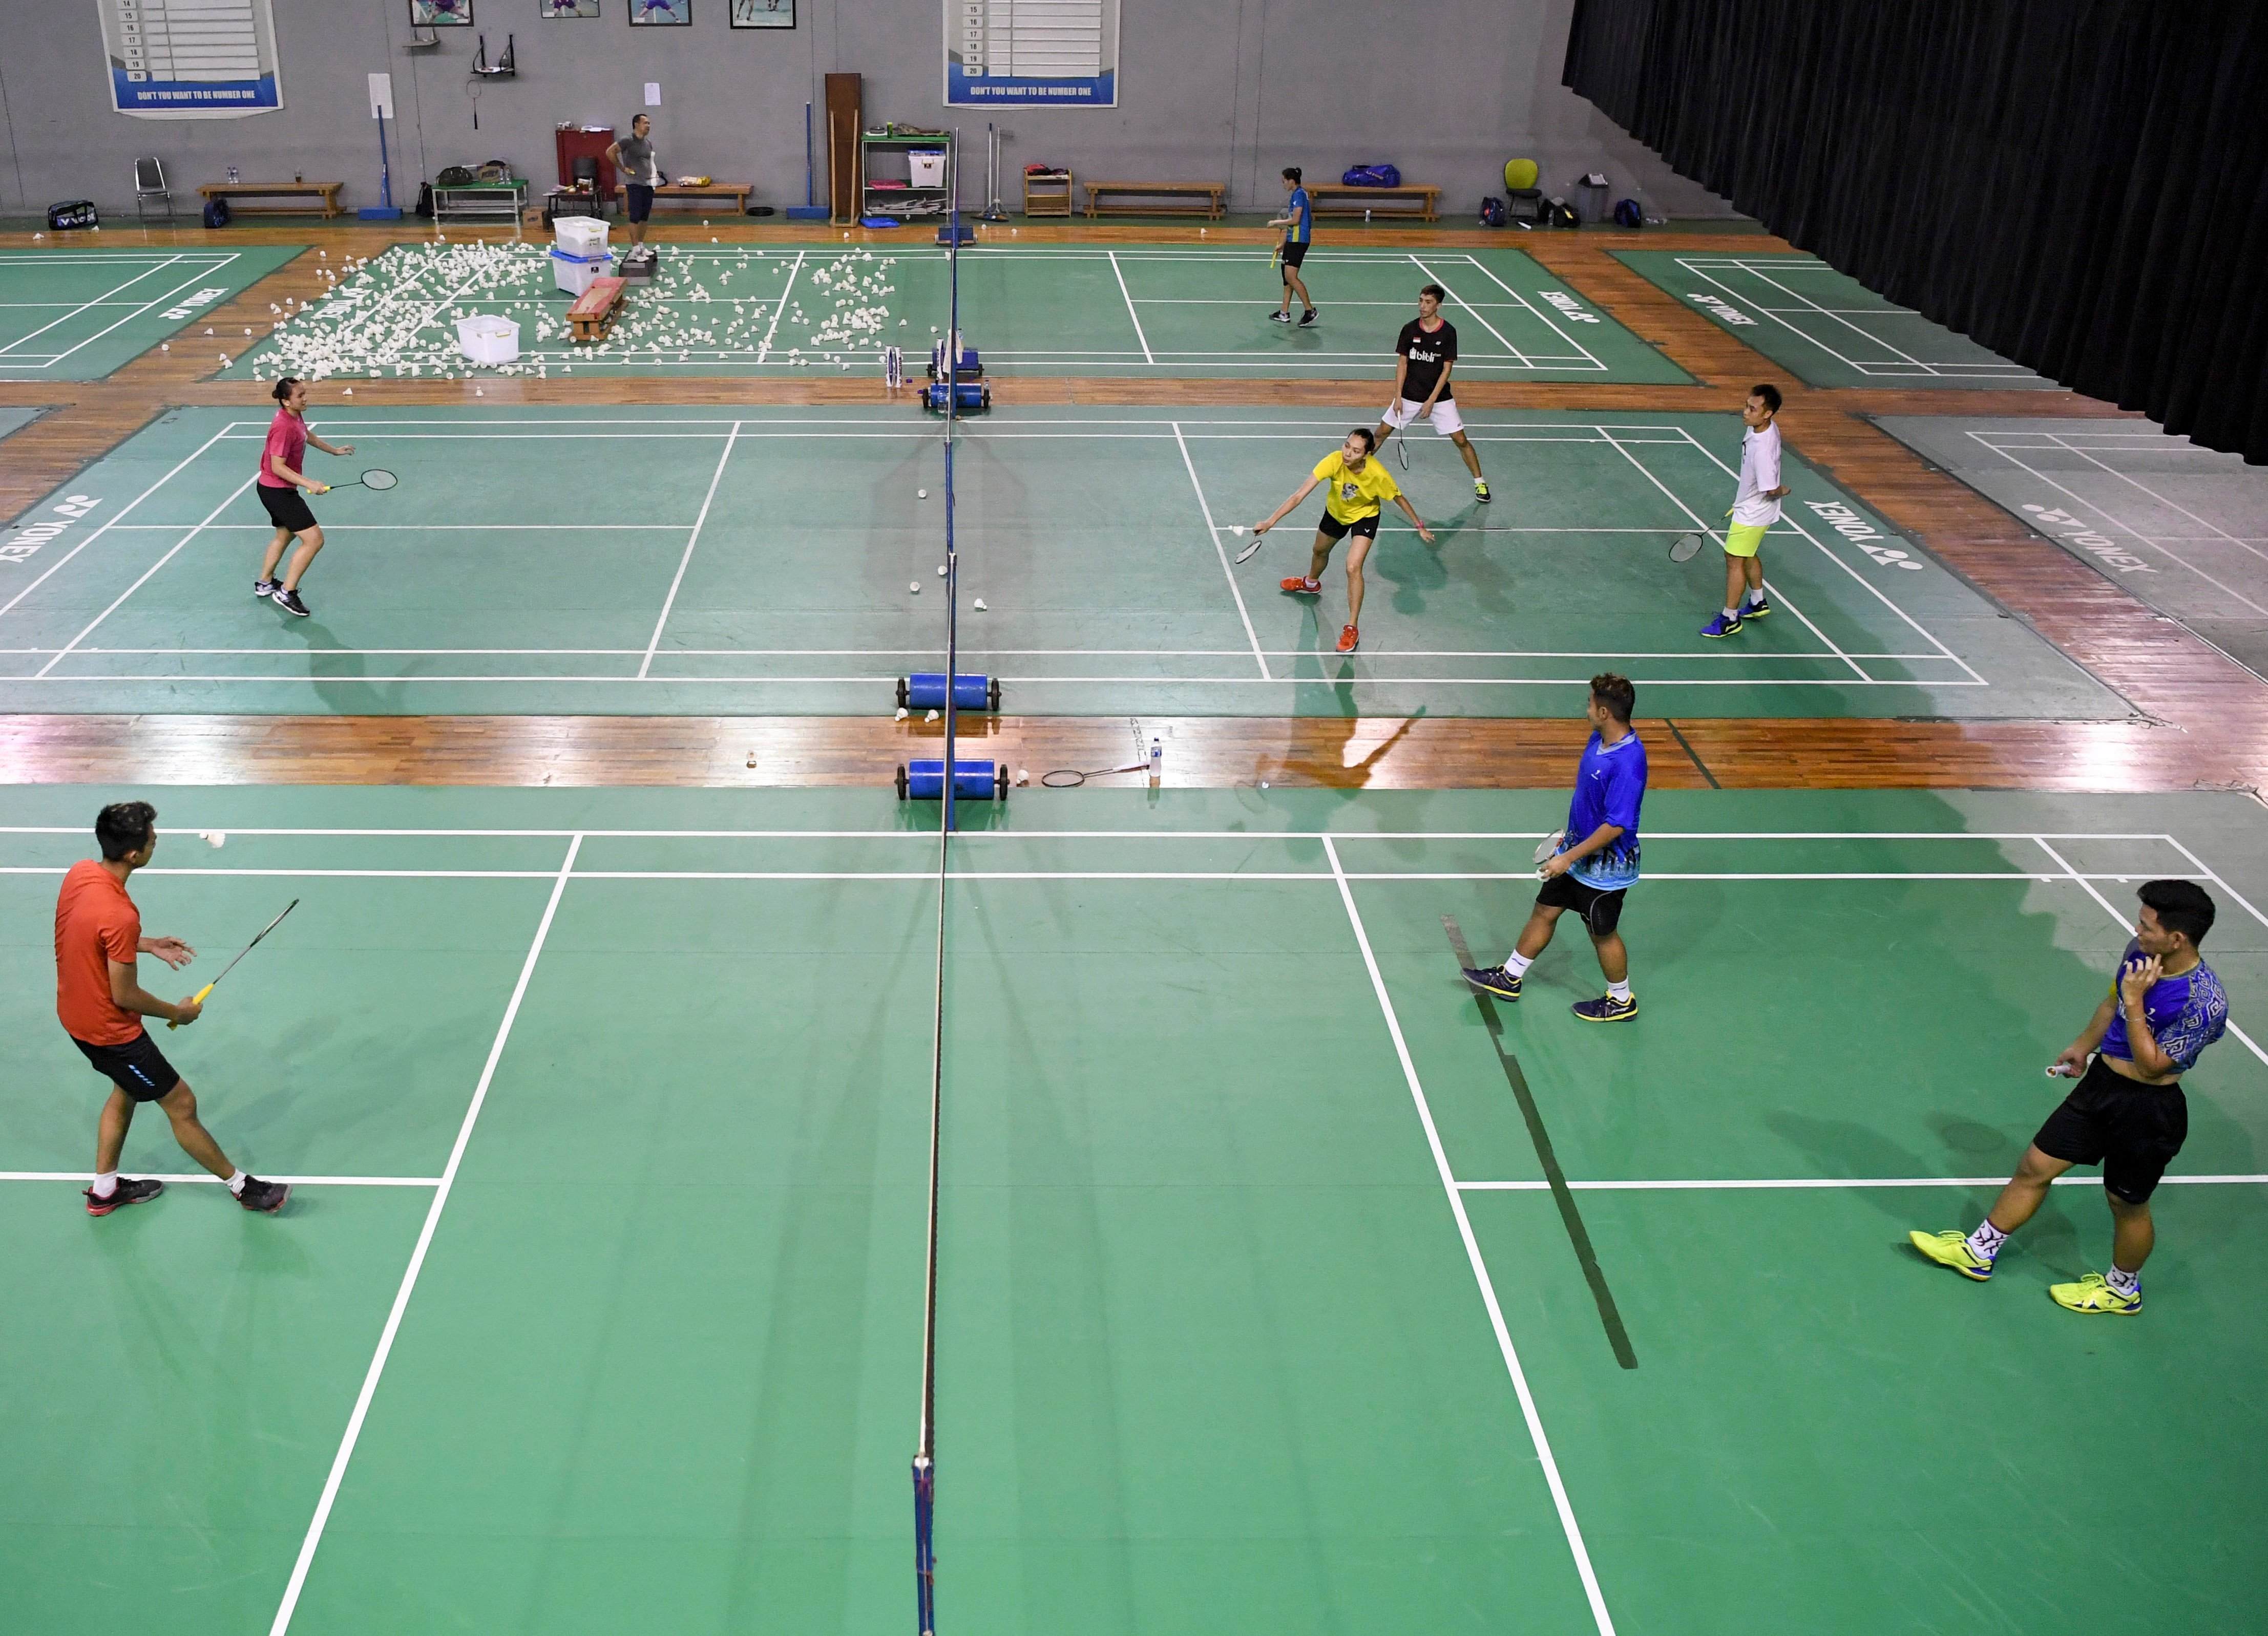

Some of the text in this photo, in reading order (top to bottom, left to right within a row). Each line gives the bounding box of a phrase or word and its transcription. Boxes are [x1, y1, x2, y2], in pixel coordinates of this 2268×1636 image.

[137, 90, 256, 100] DON'T YOU WANT TO BE NUMBER ONE
[970, 87, 1091, 96] DON'T YOU WANT TO BE NUMBER ONE
[175, 288, 229, 307] YONEX
[1537, 291, 1583, 310] YONEX
[1706, 305, 1759, 325] YONEX
[1803, 500, 1884, 542] YONEX
[0, 519, 76, 563] YONEX
[2063, 530, 2159, 573] YONEX
